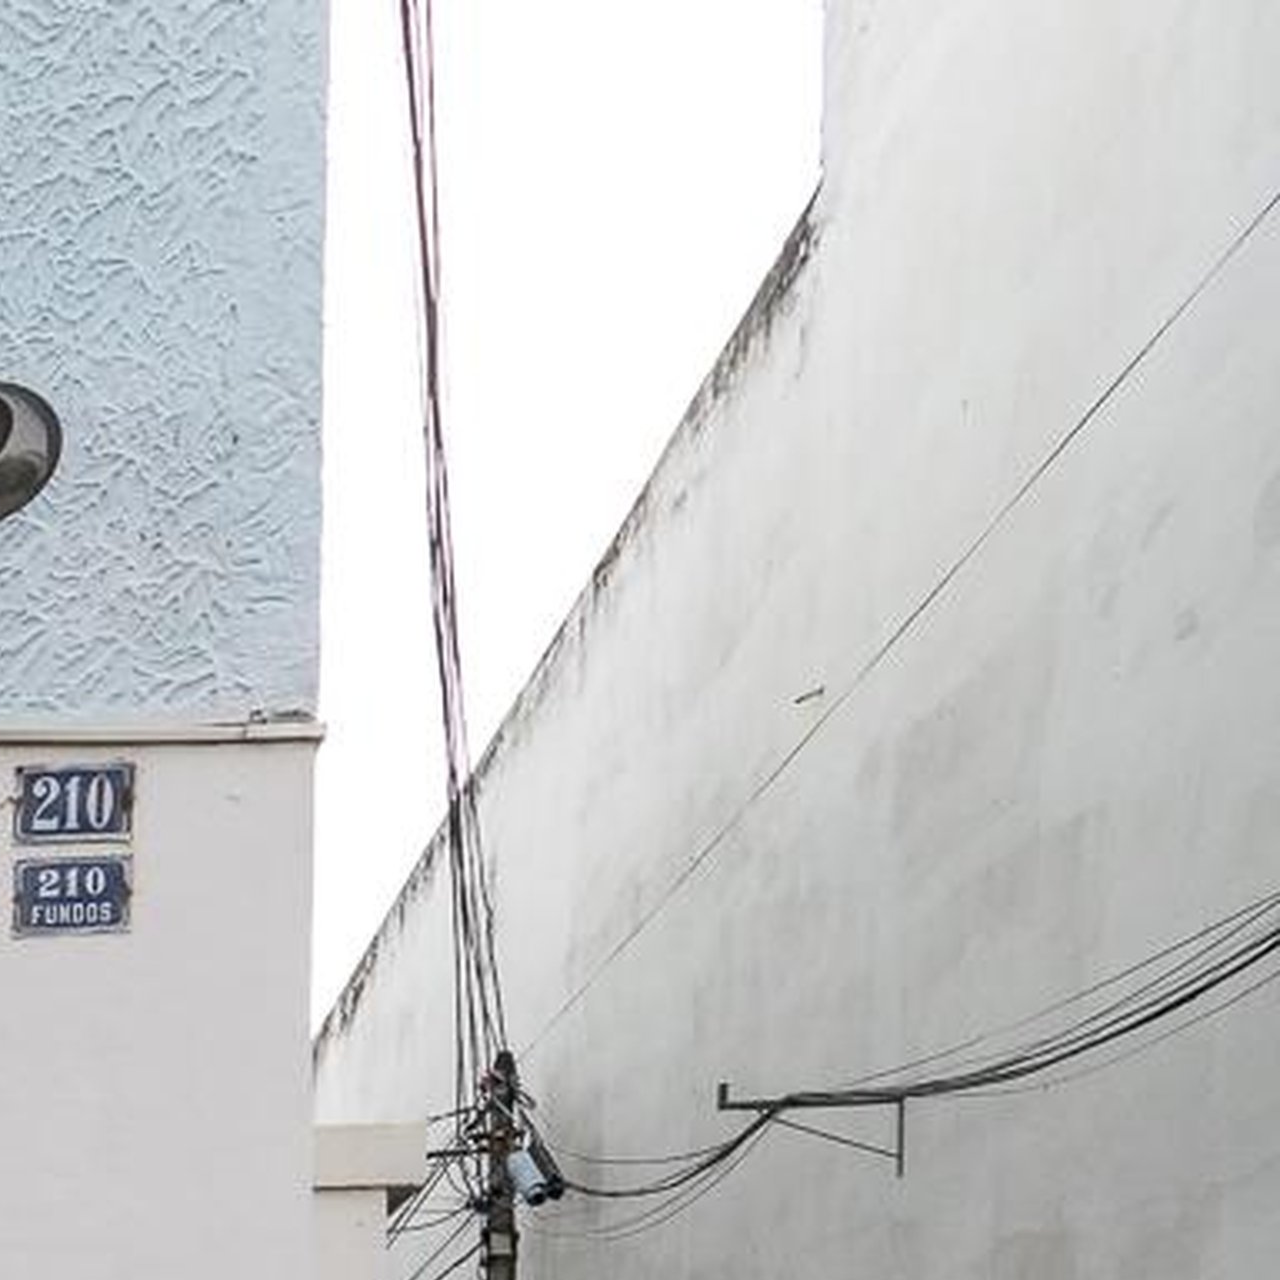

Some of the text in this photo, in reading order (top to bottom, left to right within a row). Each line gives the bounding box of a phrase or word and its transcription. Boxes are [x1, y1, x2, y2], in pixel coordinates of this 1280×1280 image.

[31, 774, 114, 830] 210
[39, 866, 105, 897] 210
[31, 902, 112, 924] FUNDOS
